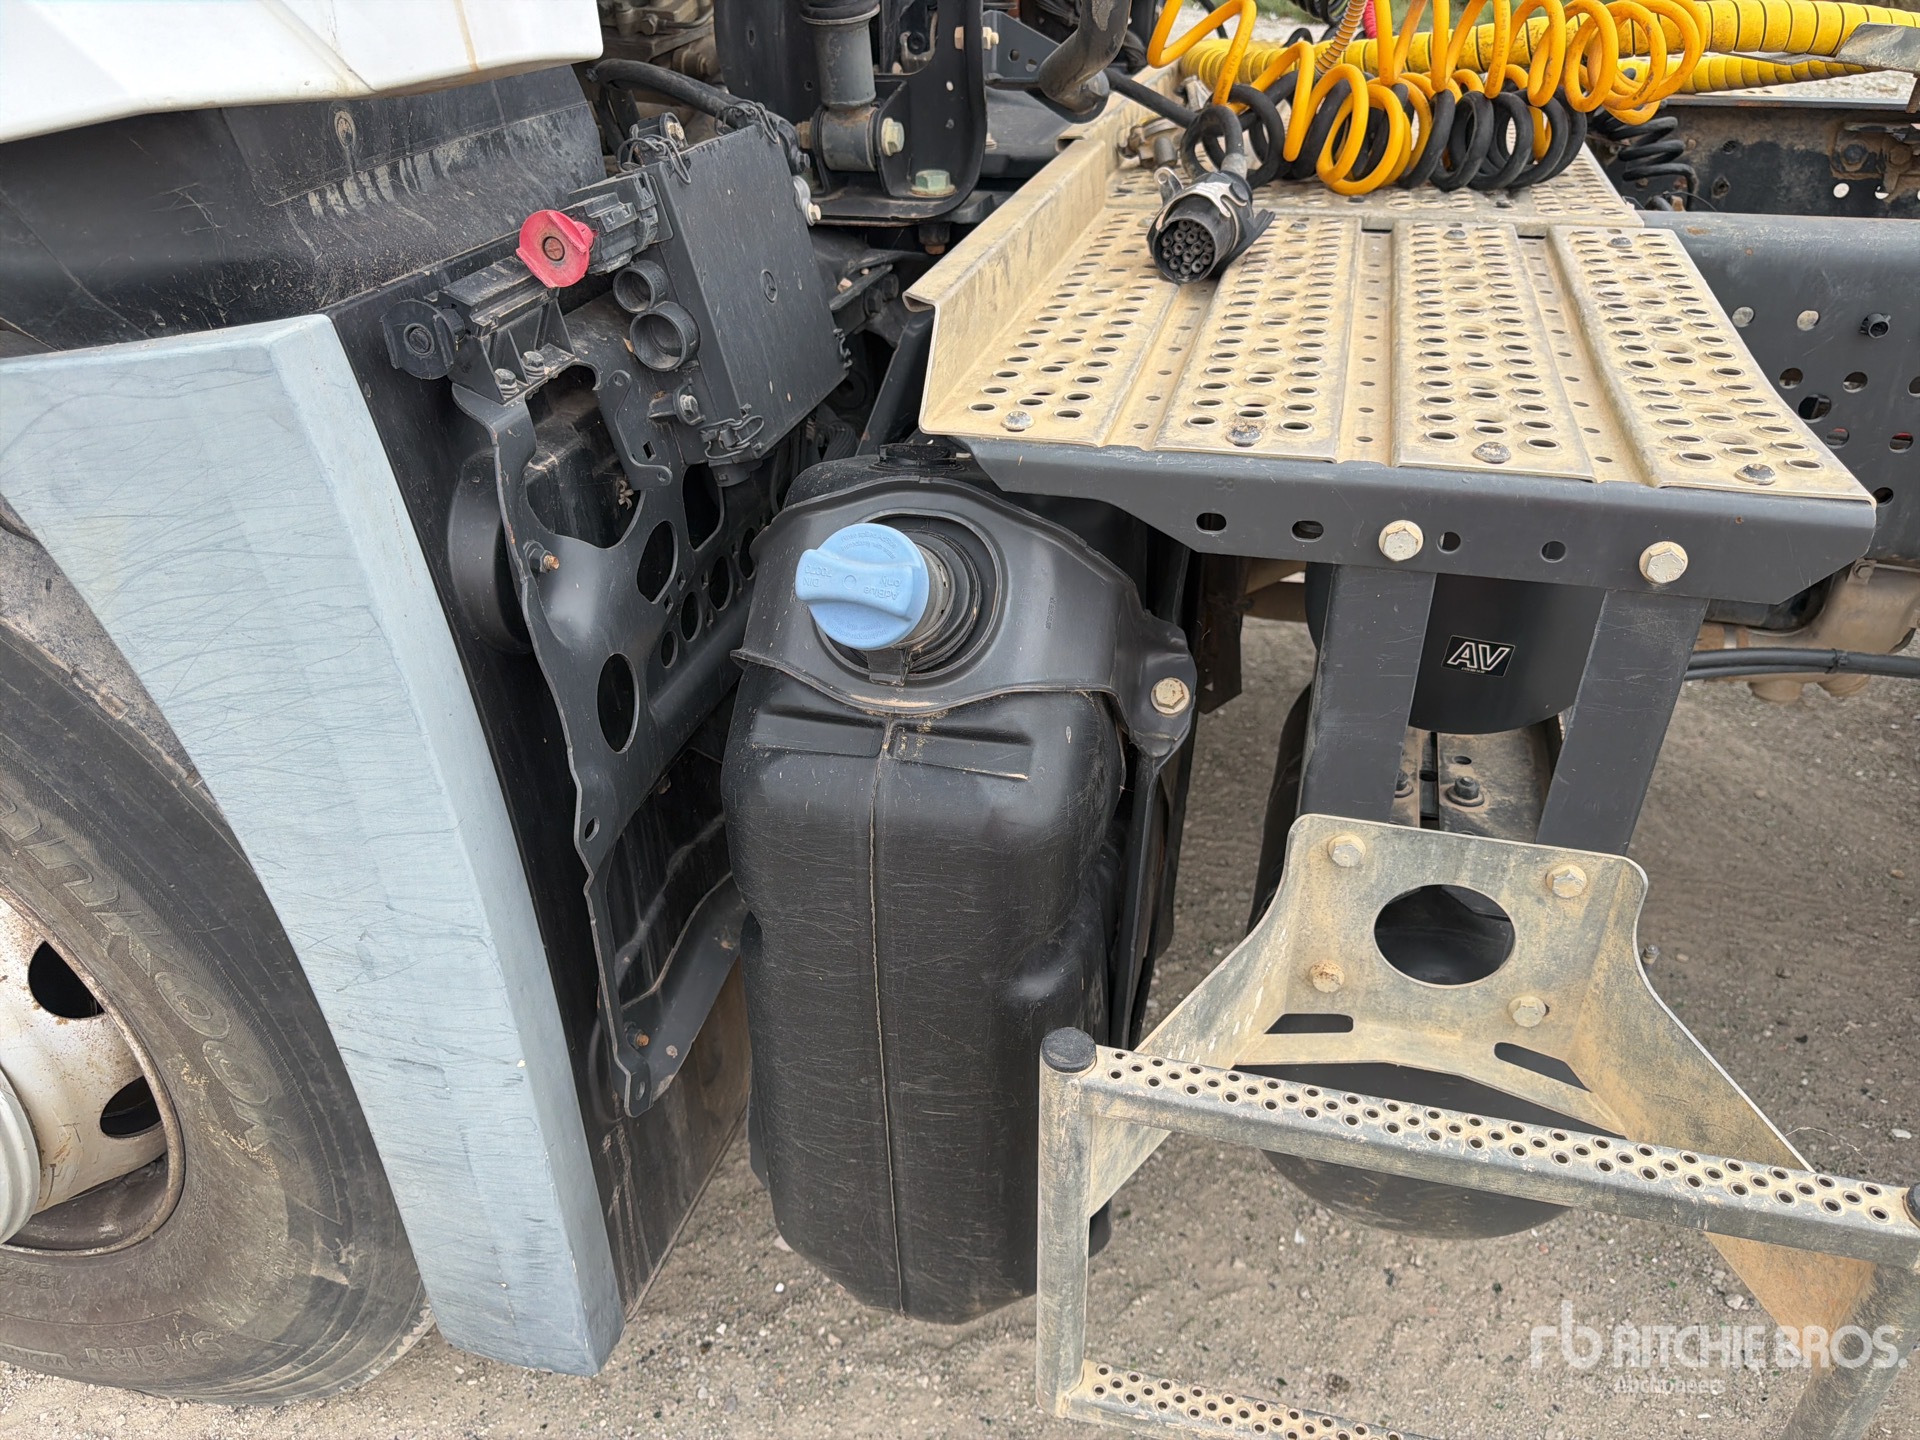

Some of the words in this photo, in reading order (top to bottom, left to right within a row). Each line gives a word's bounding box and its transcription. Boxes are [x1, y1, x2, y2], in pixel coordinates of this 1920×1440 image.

[802, 577, 821, 588] DIN
[880, 575, 901, 588] only
[863, 586, 899, 601] AdBlue
[1446, 641, 1511, 671] AV
